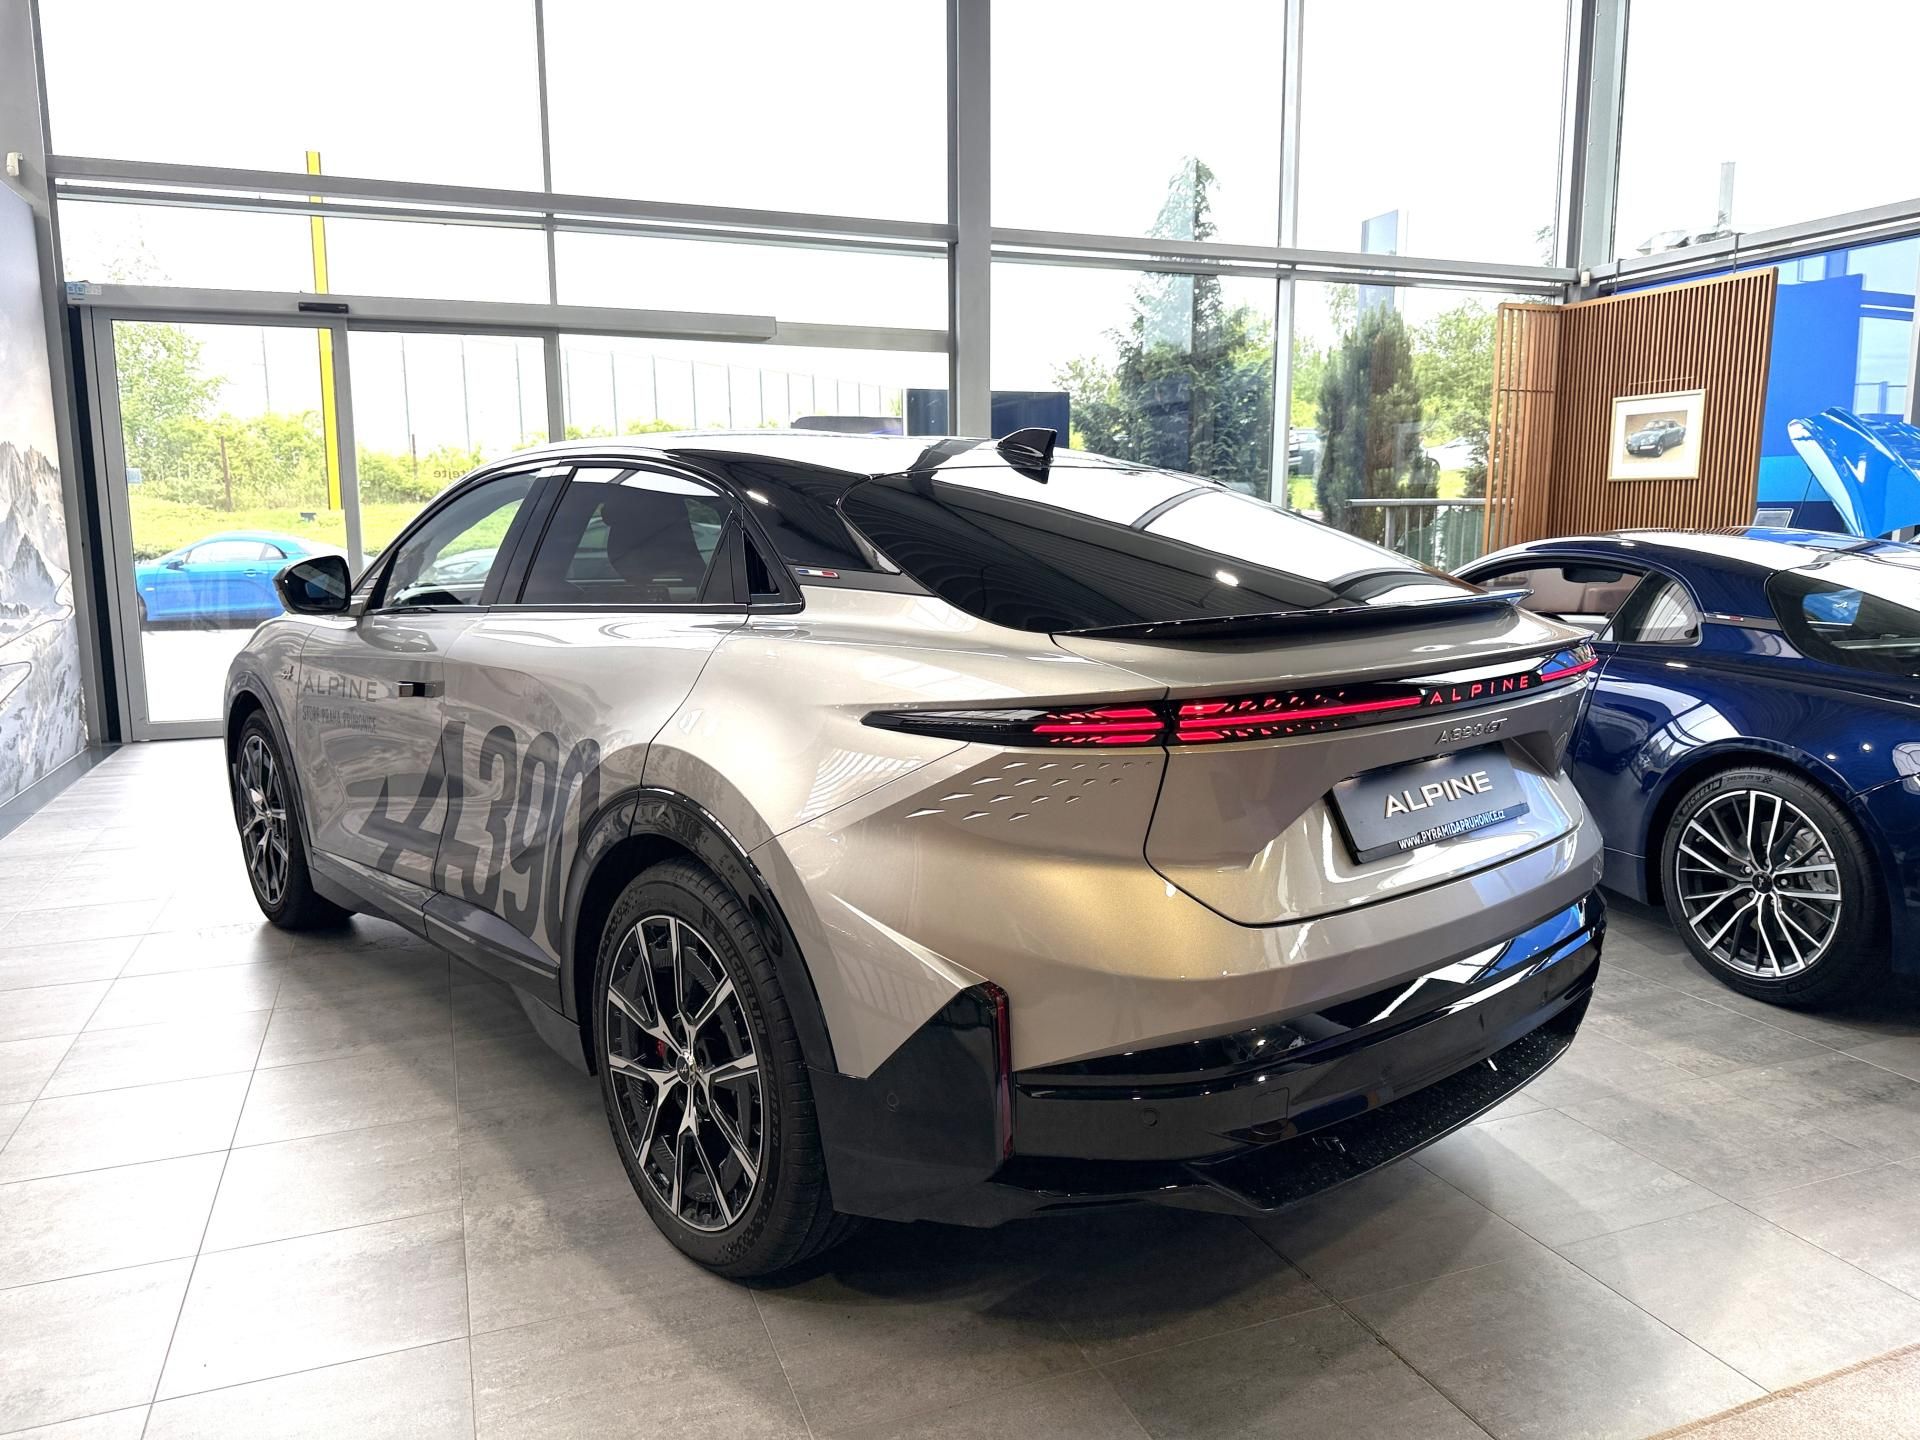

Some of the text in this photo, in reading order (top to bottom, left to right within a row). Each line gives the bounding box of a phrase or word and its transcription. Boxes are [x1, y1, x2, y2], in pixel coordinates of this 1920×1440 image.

[303, 675, 378, 702] ALPINE
[1430, 675, 1529, 705] ALPINE
[1435, 723, 1483, 745] A390
[1384, 770, 1493, 819] ALPINE
[1682, 780, 1721, 815] MICHELIN
[716, 931, 768, 1036] MICHELIN
